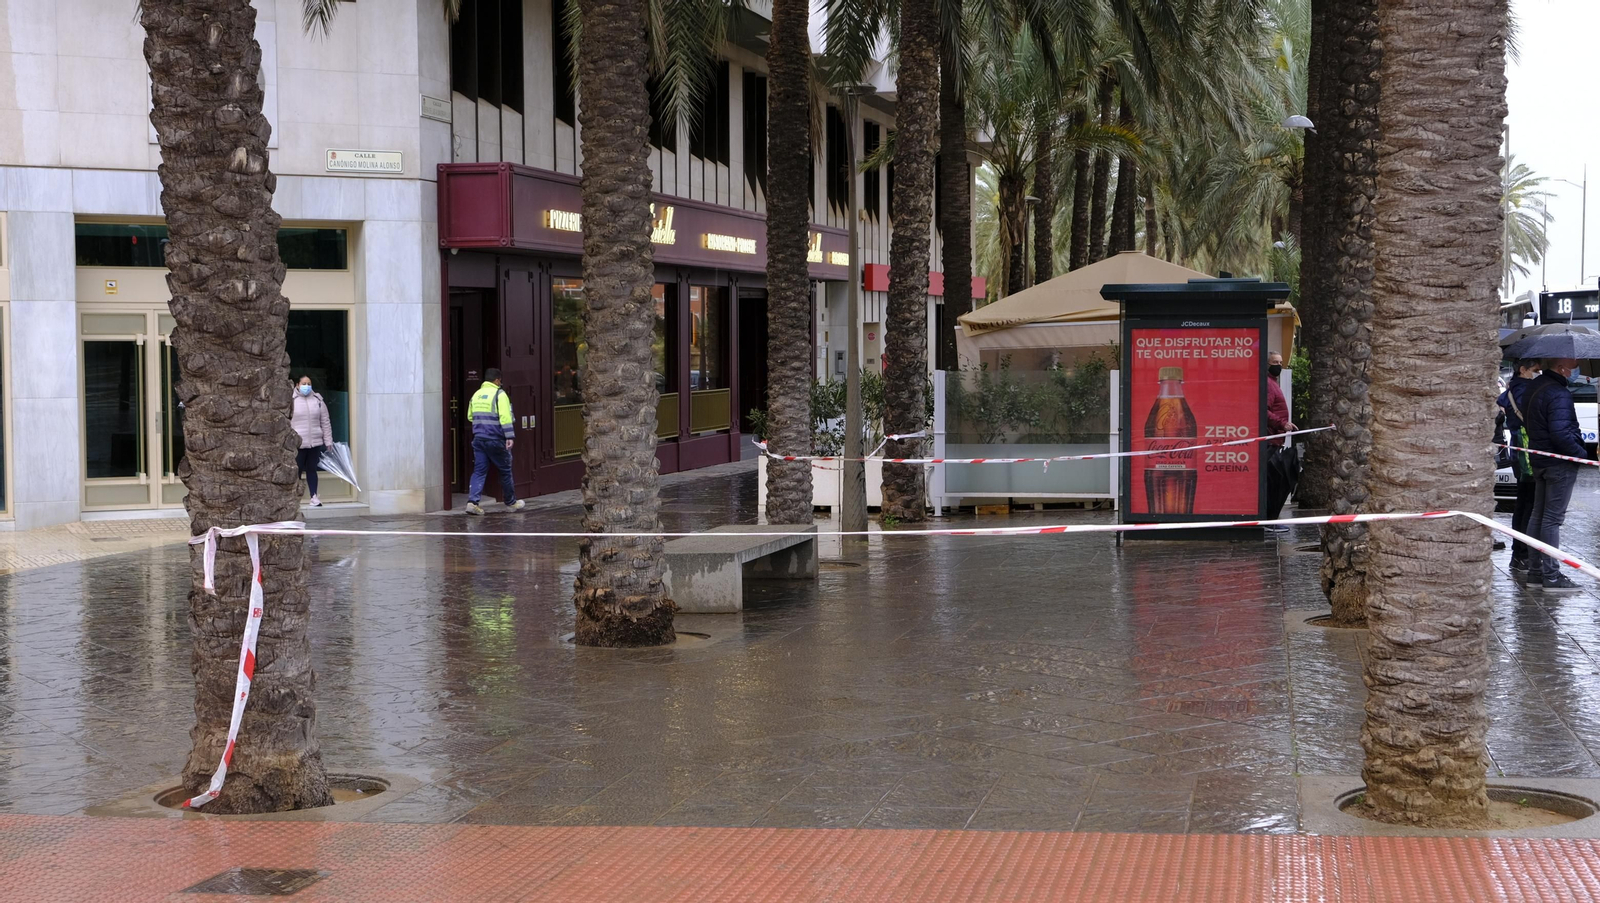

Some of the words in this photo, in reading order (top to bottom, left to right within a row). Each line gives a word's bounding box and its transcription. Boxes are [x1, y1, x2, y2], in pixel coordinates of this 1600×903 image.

[329, 159, 357, 168] CANÓNIGO
[358, 160, 378, 169] MOLINA
[380, 161, 400, 170] ALONSO
[1557, 298, 1572, 314] 18
[1136, 338, 1161, 347] QUE
[1165, 337, 1232, 347] DISFRUTAR
[1234, 337, 1253, 346] NO
[1136, 349, 1151, 358] TE
[1154, 349, 1190, 359] QUITE
[1193, 349, 1208, 358] EL
[1211, 347, 1253, 358] SUEÑO
[1204, 426, 1249, 438] ZERO
[1204, 451, 1249, 463] ZERO
[1205, 463, 1249, 472] CAFEÍNA
